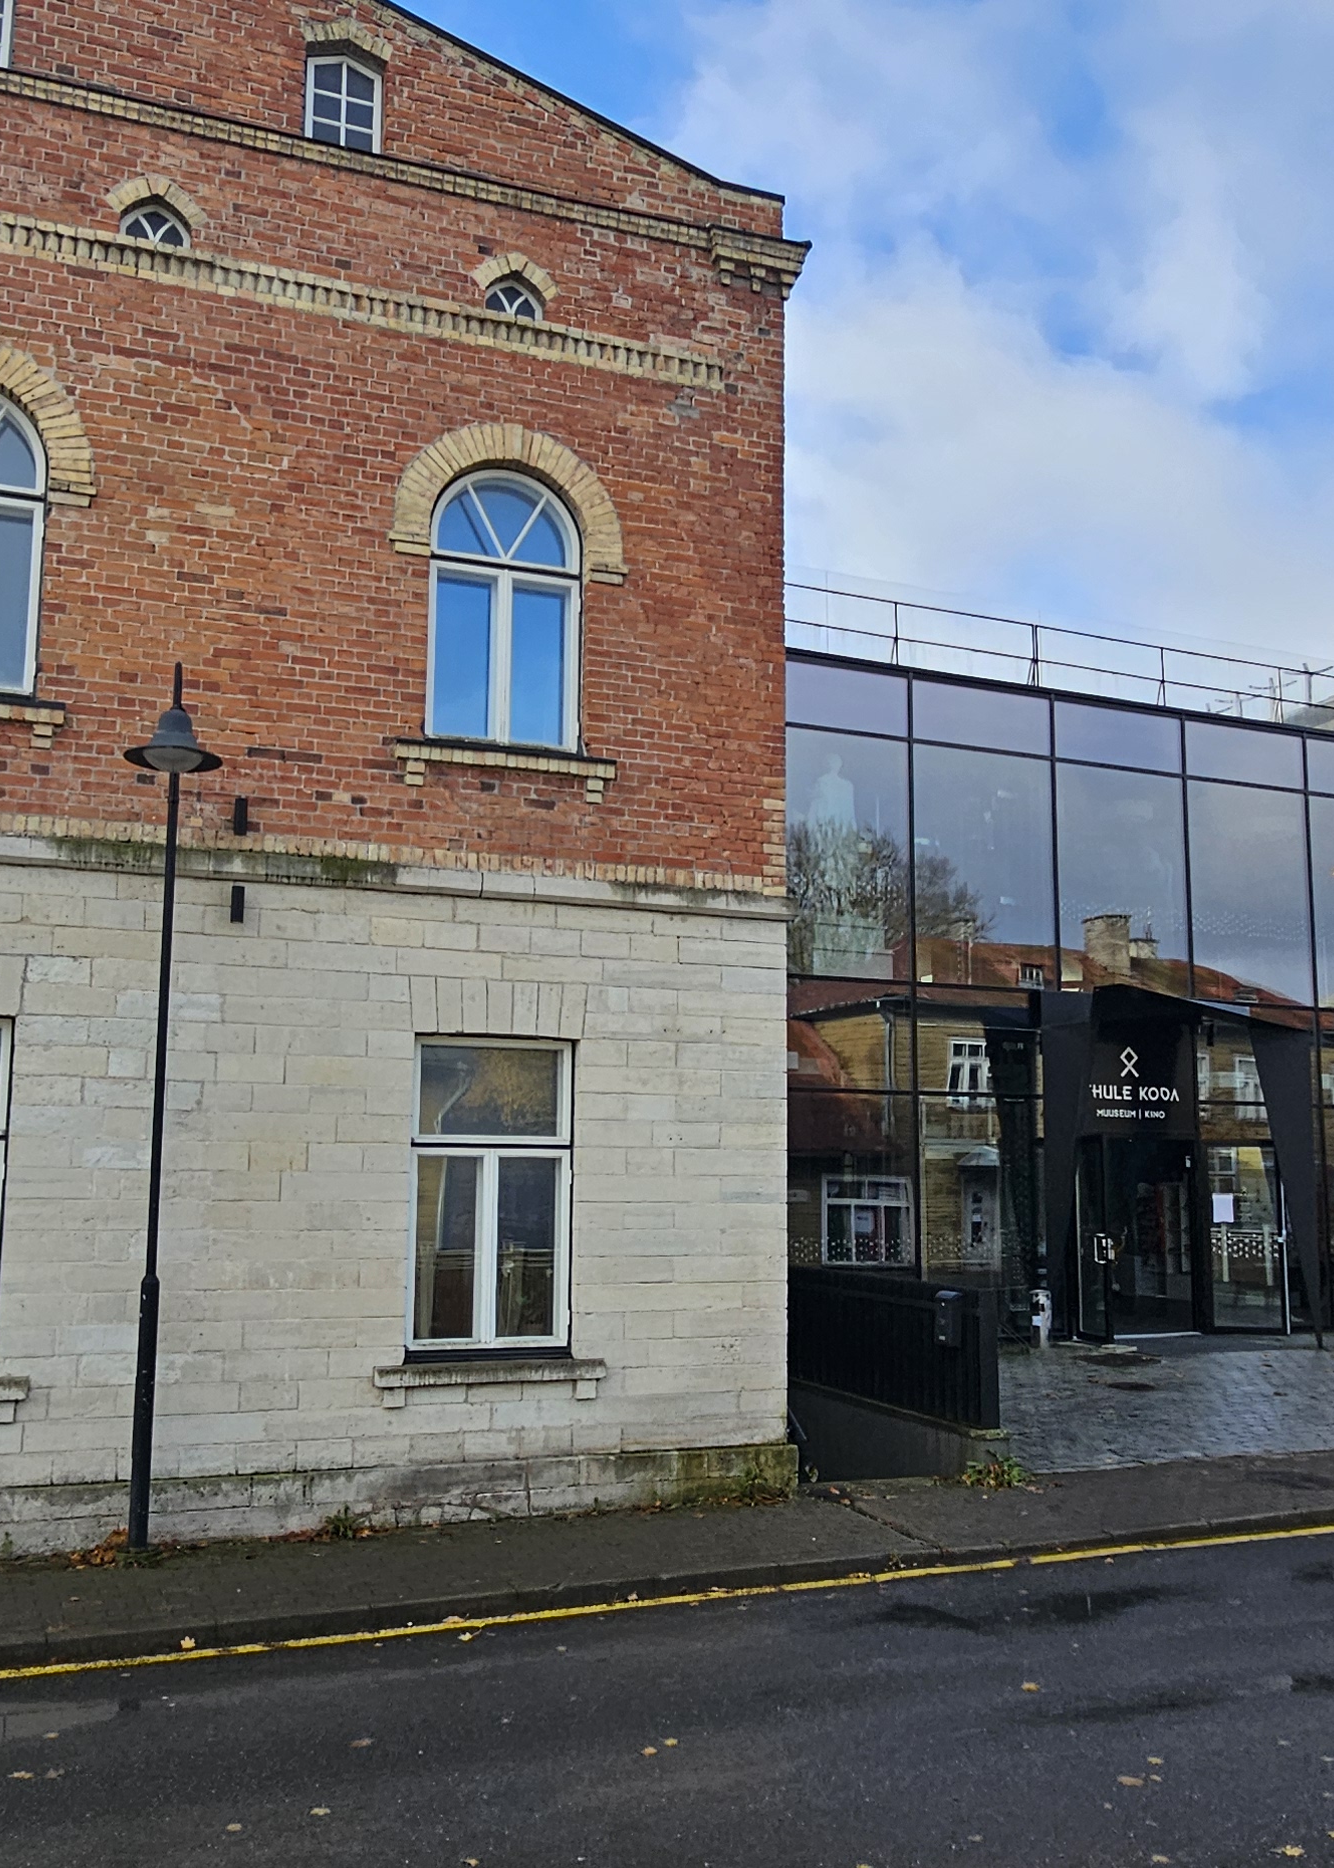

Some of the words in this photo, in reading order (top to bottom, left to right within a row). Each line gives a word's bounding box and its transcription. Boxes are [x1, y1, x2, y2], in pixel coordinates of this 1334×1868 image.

[1089, 1084, 1133, 1100] HULE
[1139, 1086, 1180, 1102] KODA
[1096, 1108, 1137, 1118] MUUSEUM
[1144, 1110, 1166, 1119] KINO
